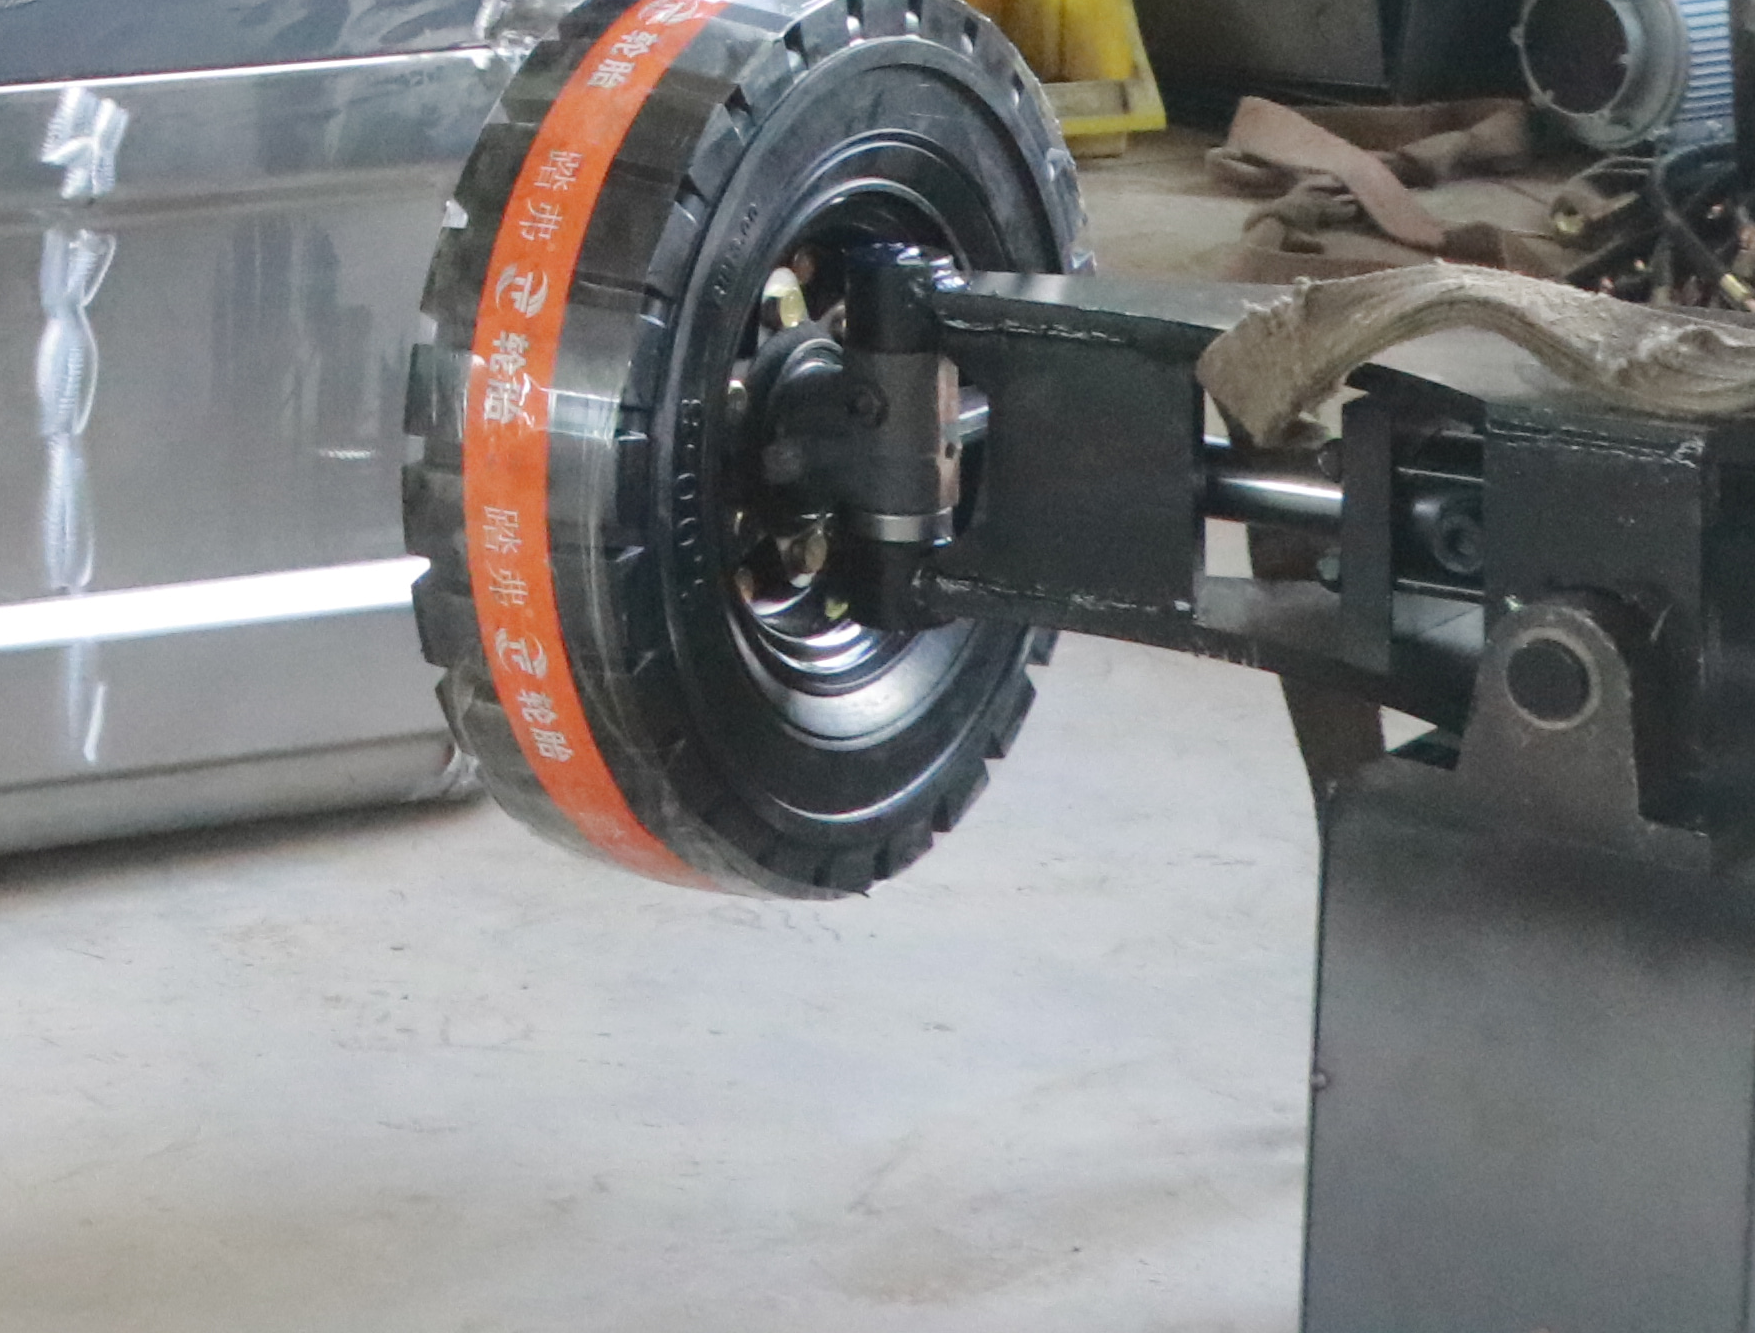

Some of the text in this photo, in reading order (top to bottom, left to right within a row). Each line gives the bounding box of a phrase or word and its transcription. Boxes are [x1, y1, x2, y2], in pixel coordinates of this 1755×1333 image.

[586, 29, 658, 89] 轮胎
[483, 330, 531, 425] 轮胎
[517, 688, 575, 763] 轮胎
